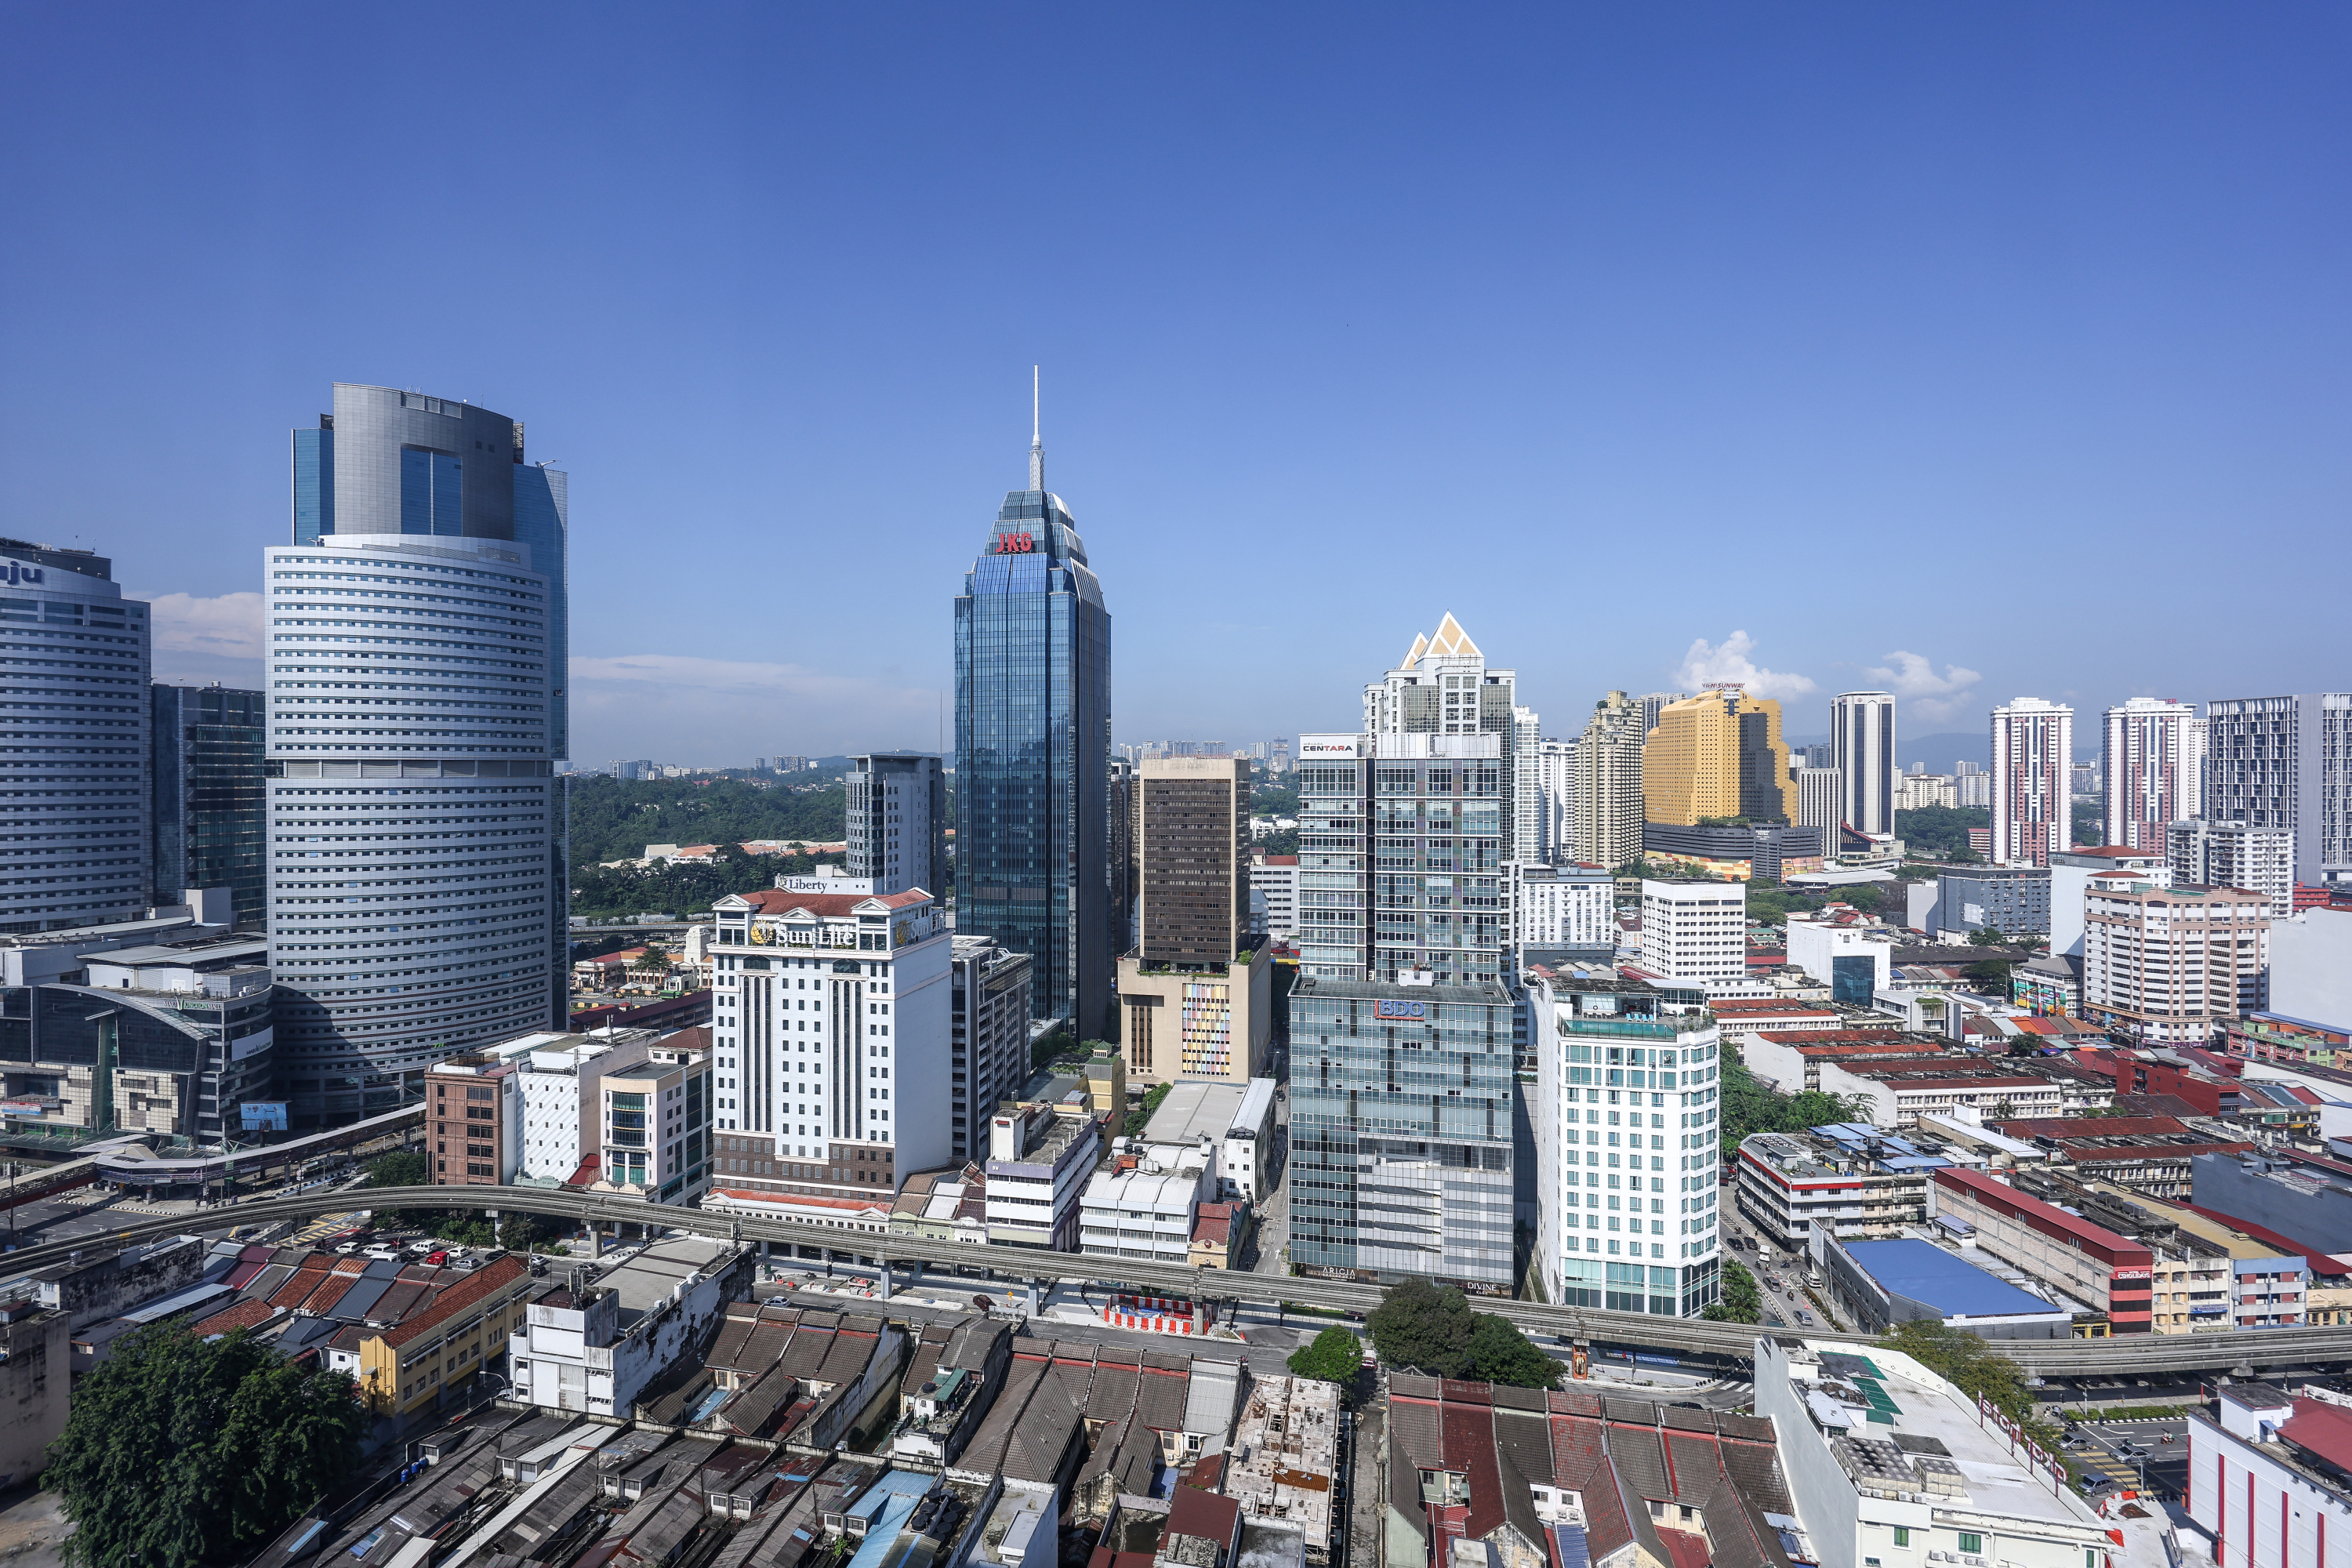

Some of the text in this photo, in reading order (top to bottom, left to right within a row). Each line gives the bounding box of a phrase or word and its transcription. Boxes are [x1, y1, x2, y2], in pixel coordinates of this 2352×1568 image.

[995, 532, 1032, 553] JKG
[789, 878, 828, 894] Liberty
[776, 924, 855, 946] Sun Life
[911, 921, 929, 939] Sun
[1381, 1000, 1425, 1016] BDO
[1323, 1266, 1356, 1276] ARICIA
[1468, 1282, 1497, 1292] DIVINE
